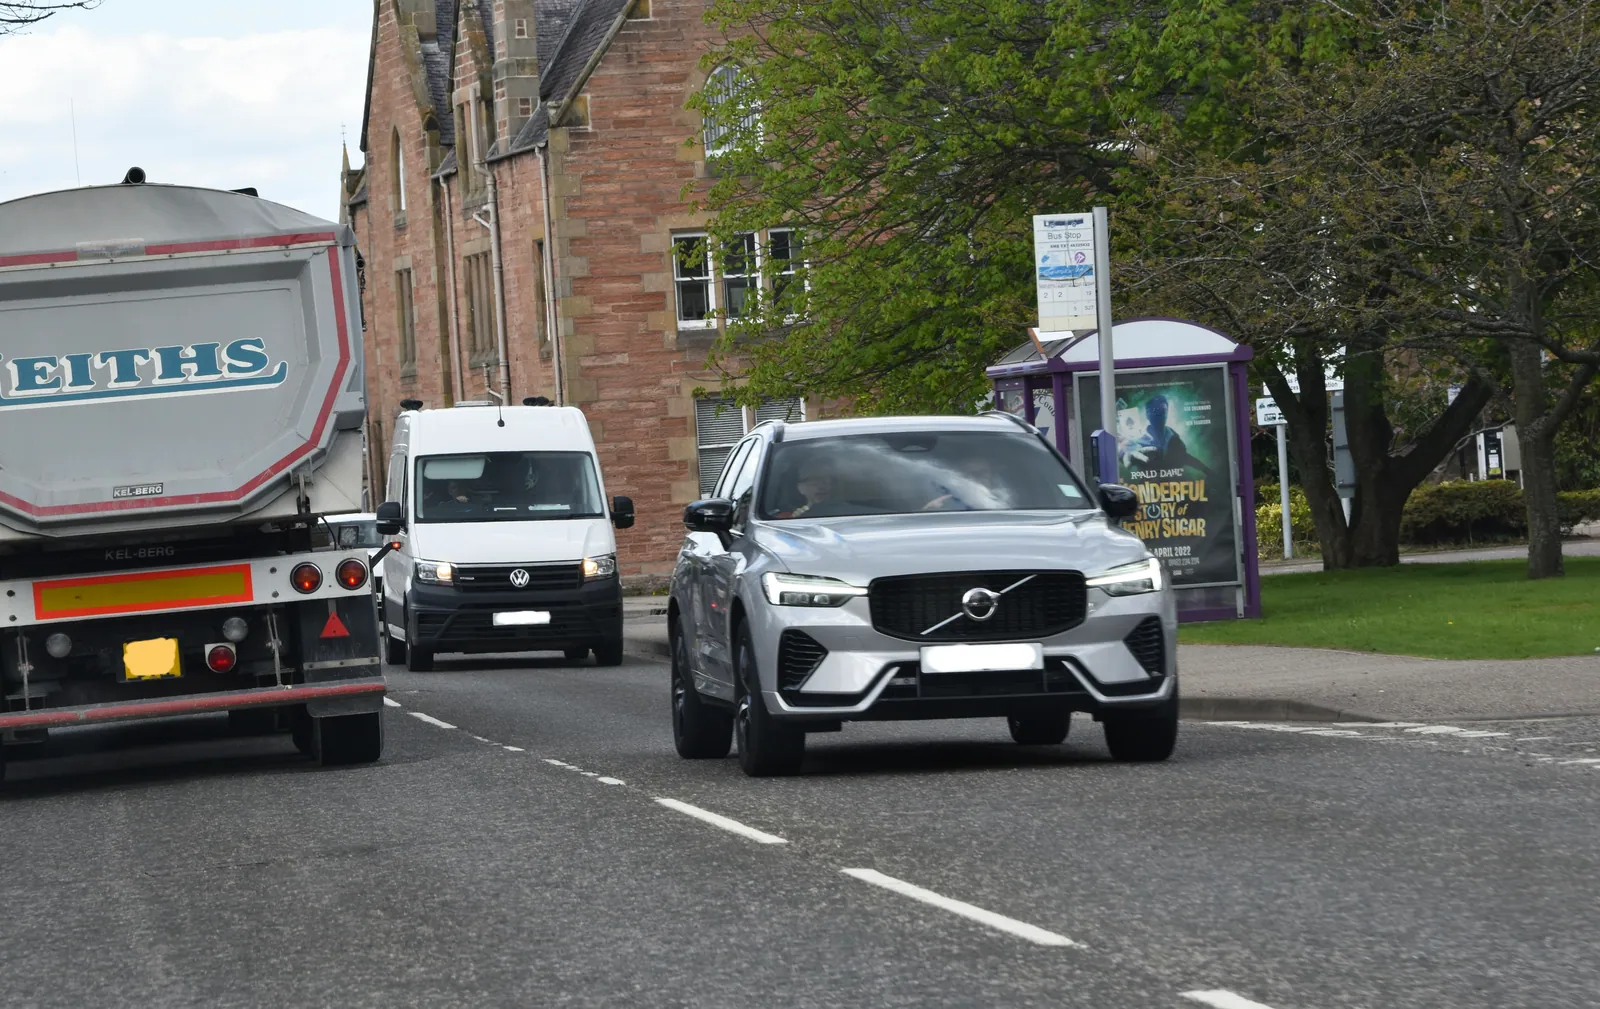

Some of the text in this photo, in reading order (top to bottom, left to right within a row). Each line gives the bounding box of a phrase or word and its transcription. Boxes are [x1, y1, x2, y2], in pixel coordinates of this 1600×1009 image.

[1047, 231, 1082, 240] Bus Stop
[0, 337, 270, 397] EITHS
[1131, 469, 1157, 479] ROALD
[114, 485, 162, 497] KEL-BERG
[1124, 480, 1208, 503] NDERFUL
[1177, 503, 1188, 515] of
[1162, 517, 1206, 538] SUGAR
[105, 546, 175, 560] KEL-BERG
[1154, 545, 1191, 558] APRIL 2022
